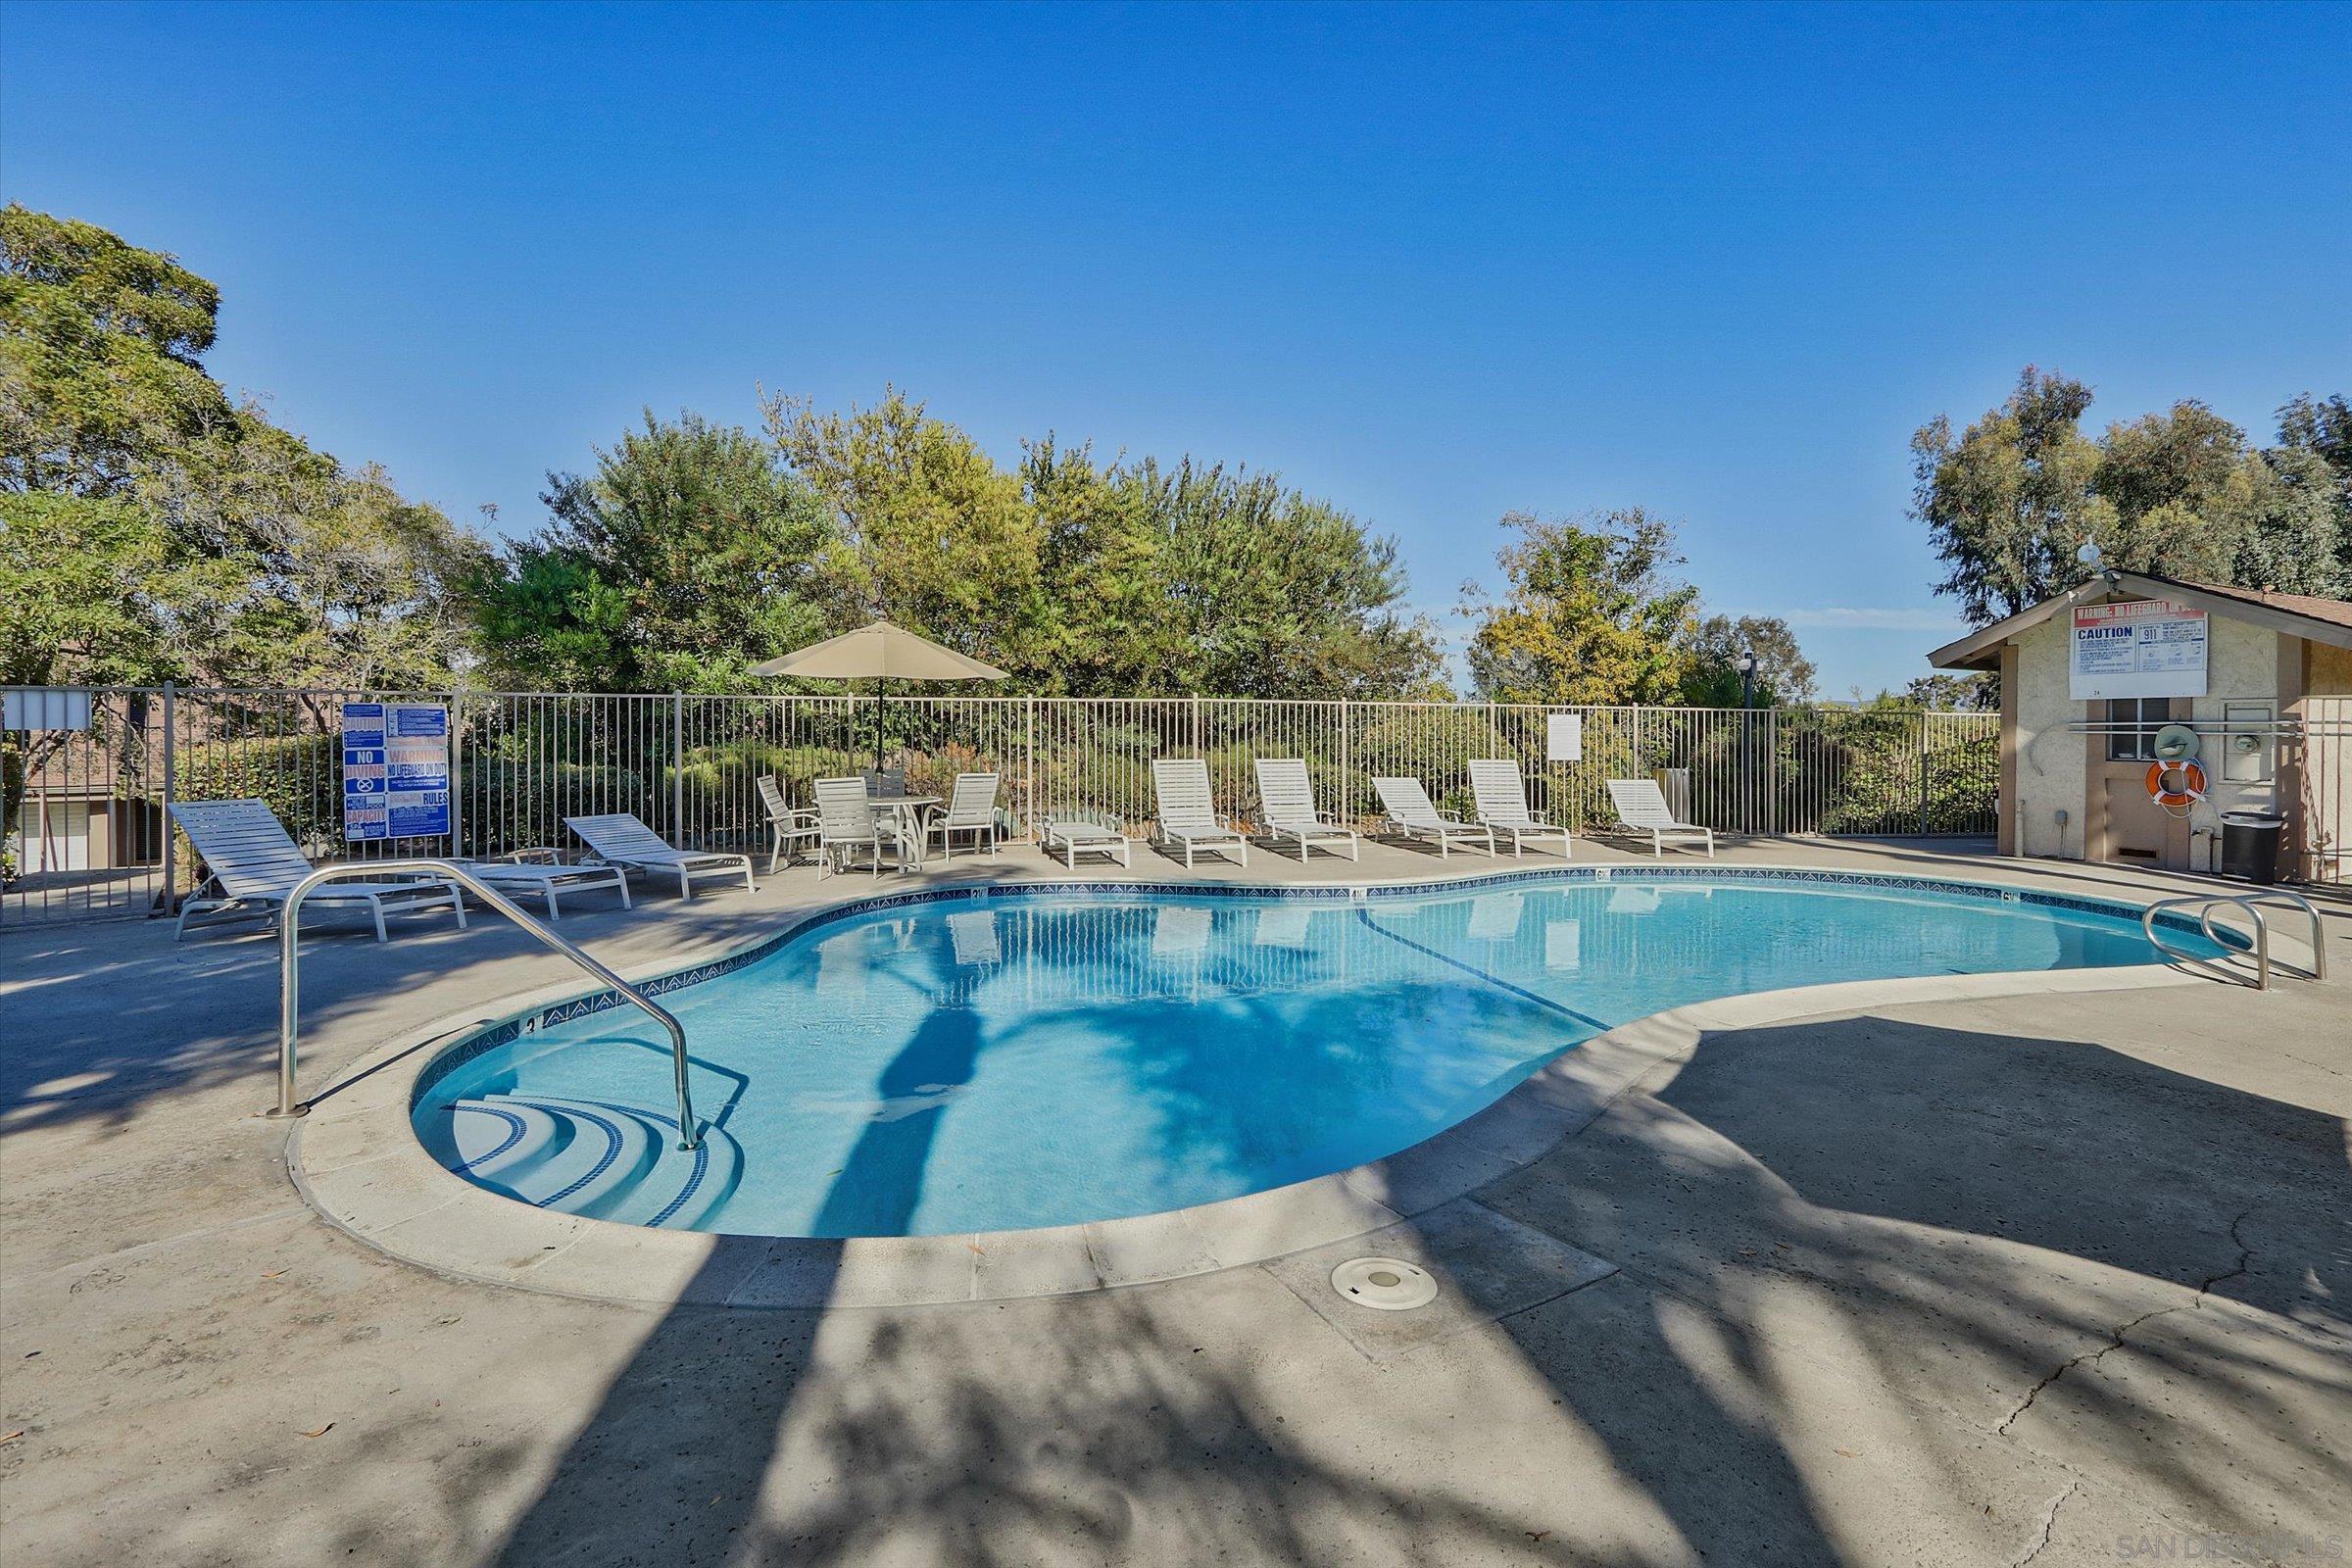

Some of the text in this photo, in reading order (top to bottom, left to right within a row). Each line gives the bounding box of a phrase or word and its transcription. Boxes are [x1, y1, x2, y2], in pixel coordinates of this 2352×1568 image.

[2078, 626, 2132, 640] CAUTION
[2144, 628, 2157, 640] 911
[357, 751, 373, 763] NO
[389, 750, 444, 762] WARNING
[345, 764, 384, 778] DIVING
[387, 763, 395, 776] NO
[396, 763, 424, 776] LIFEGUARD
[422, 792, 448, 805] RULES
[346, 809, 386, 823] CAPACITY
